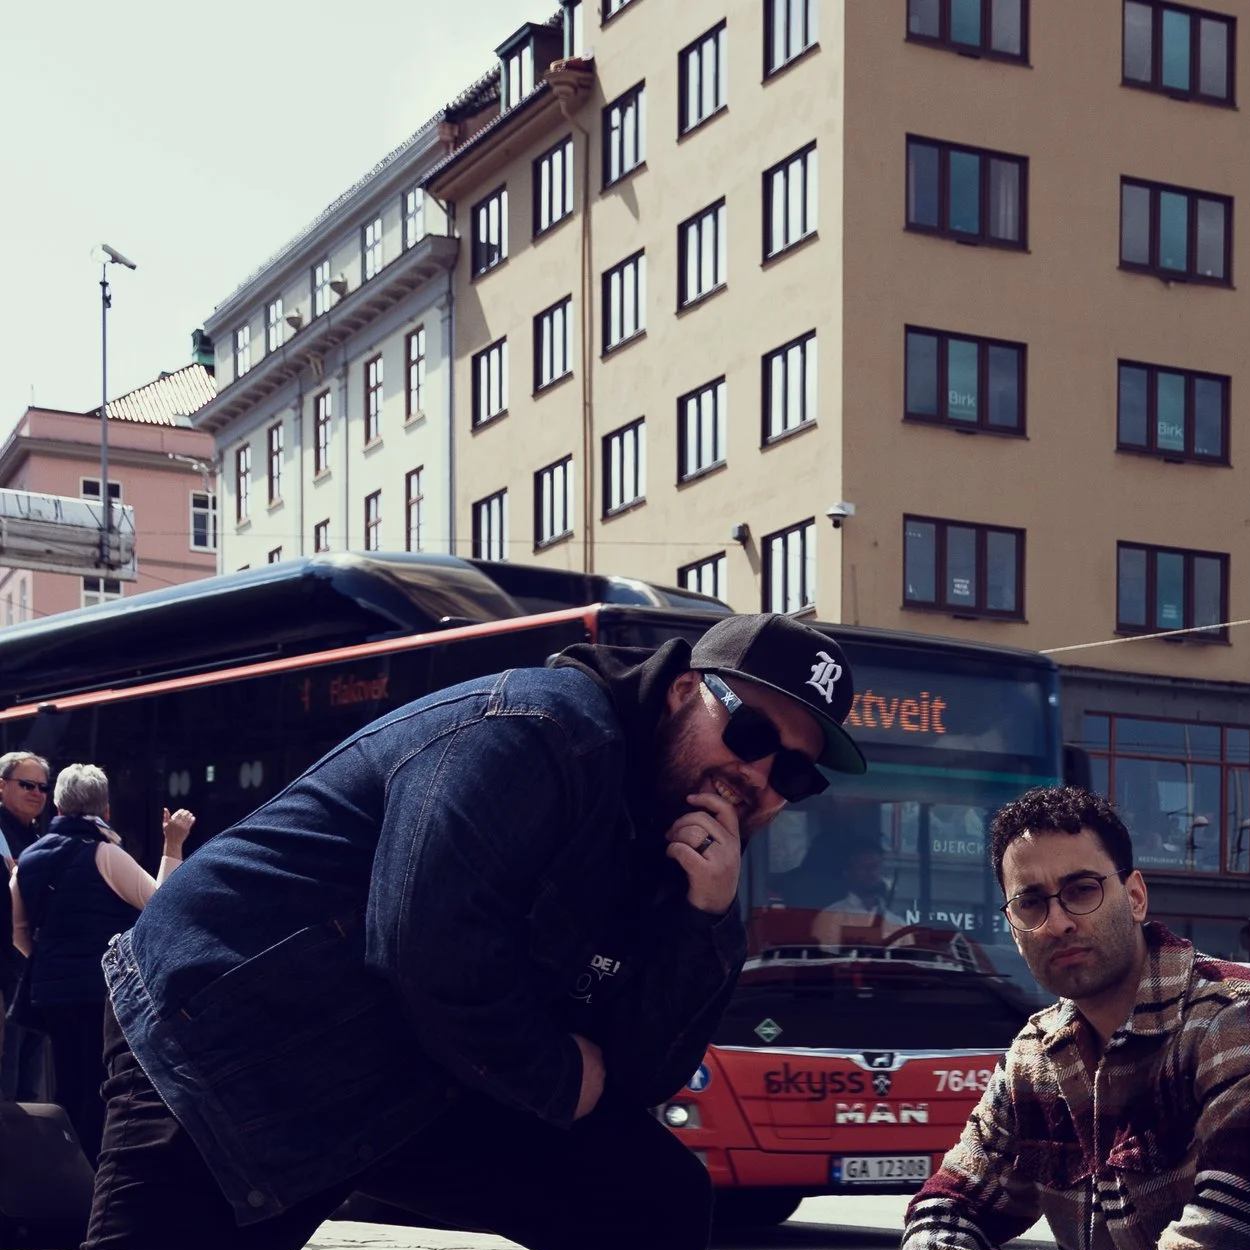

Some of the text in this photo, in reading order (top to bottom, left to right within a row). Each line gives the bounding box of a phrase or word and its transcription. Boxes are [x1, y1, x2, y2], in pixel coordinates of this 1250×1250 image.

[949, 391, 976, 407] Birk
[1158, 422, 1183, 437] Birk
[765, 1062, 865, 1102] skyss
[836, 1103, 929, 1124] MAN
[846, 1160, 926, 1179] GA 12308
